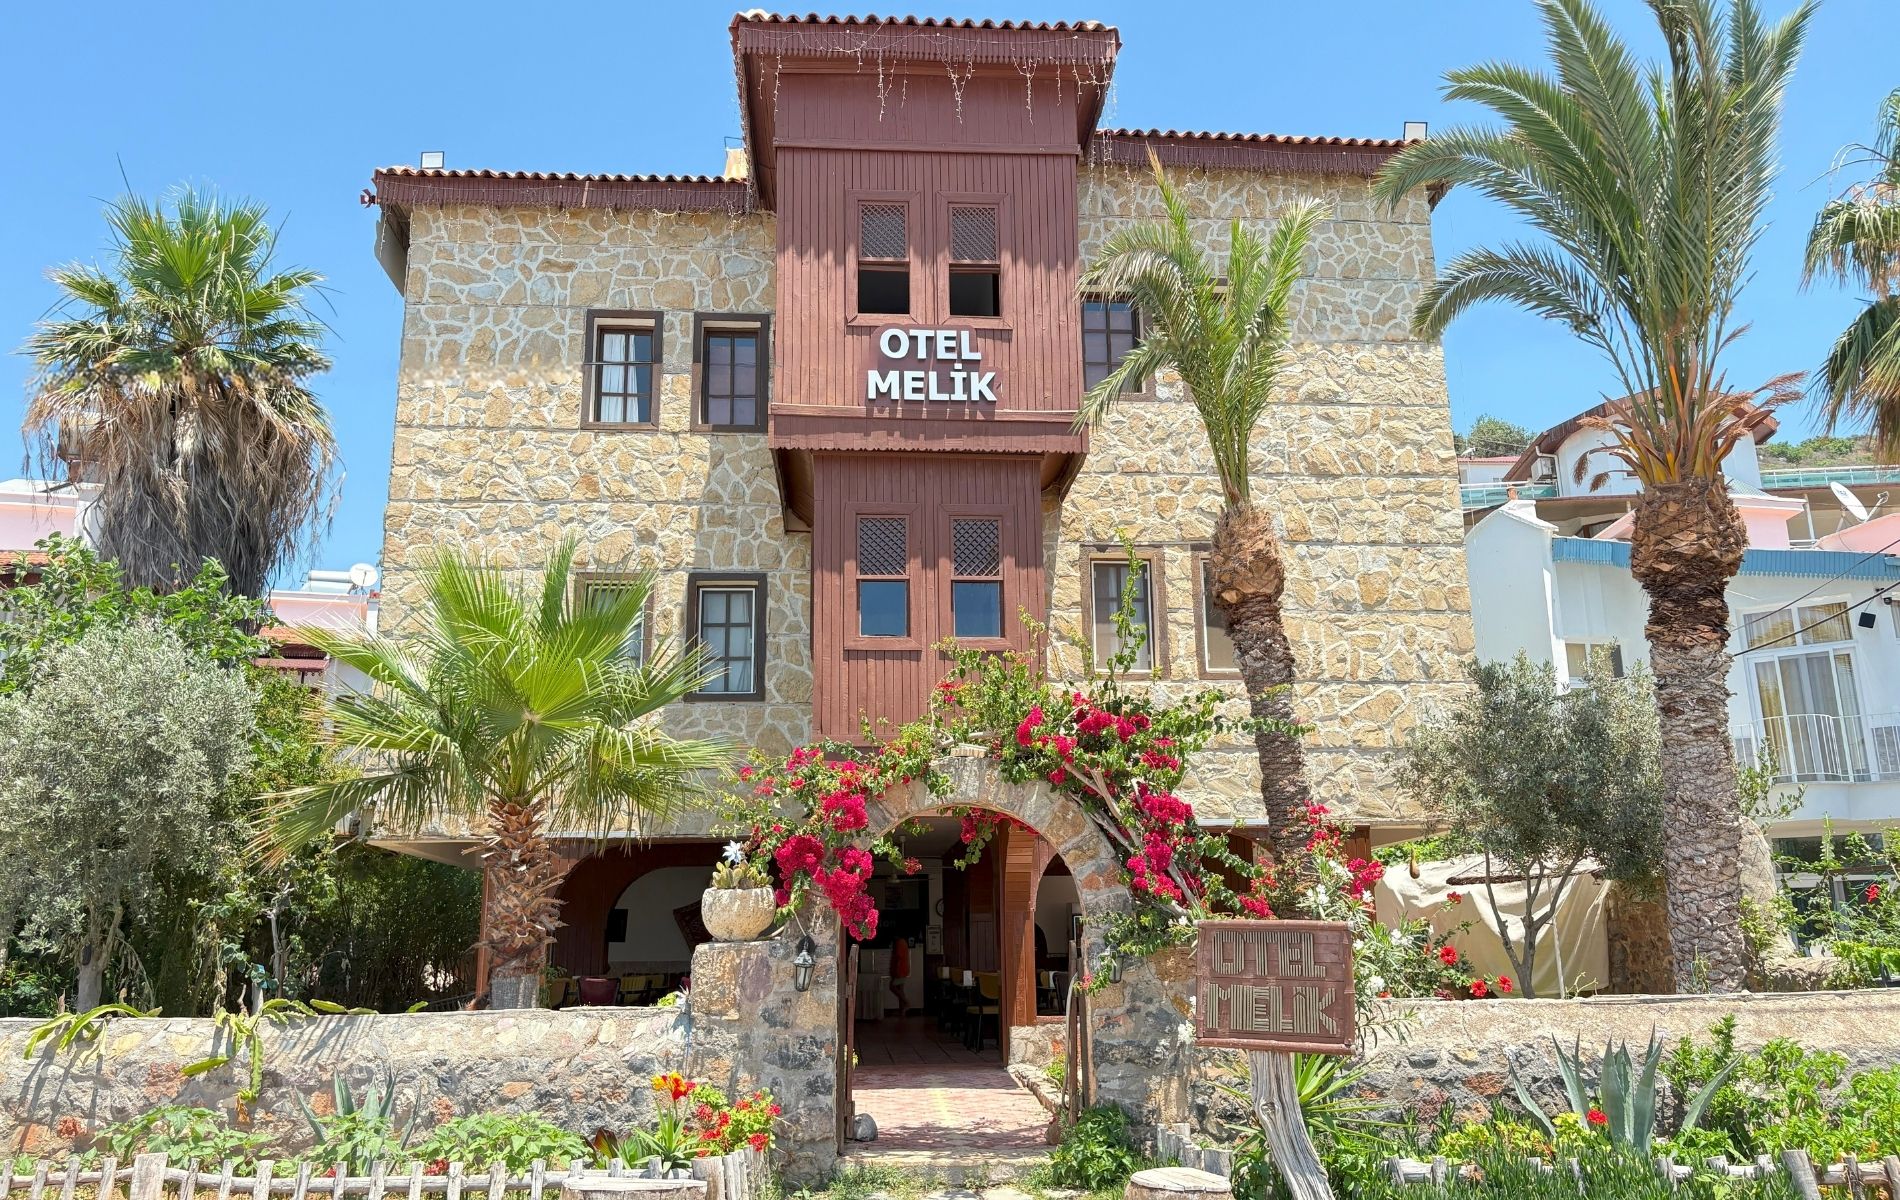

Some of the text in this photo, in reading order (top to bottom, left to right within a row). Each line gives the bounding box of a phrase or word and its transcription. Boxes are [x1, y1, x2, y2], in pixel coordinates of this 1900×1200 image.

[880, 328, 982, 360] OTEL
[867, 363, 997, 401] MELİK
[1212, 930, 1326, 978] OTEL
